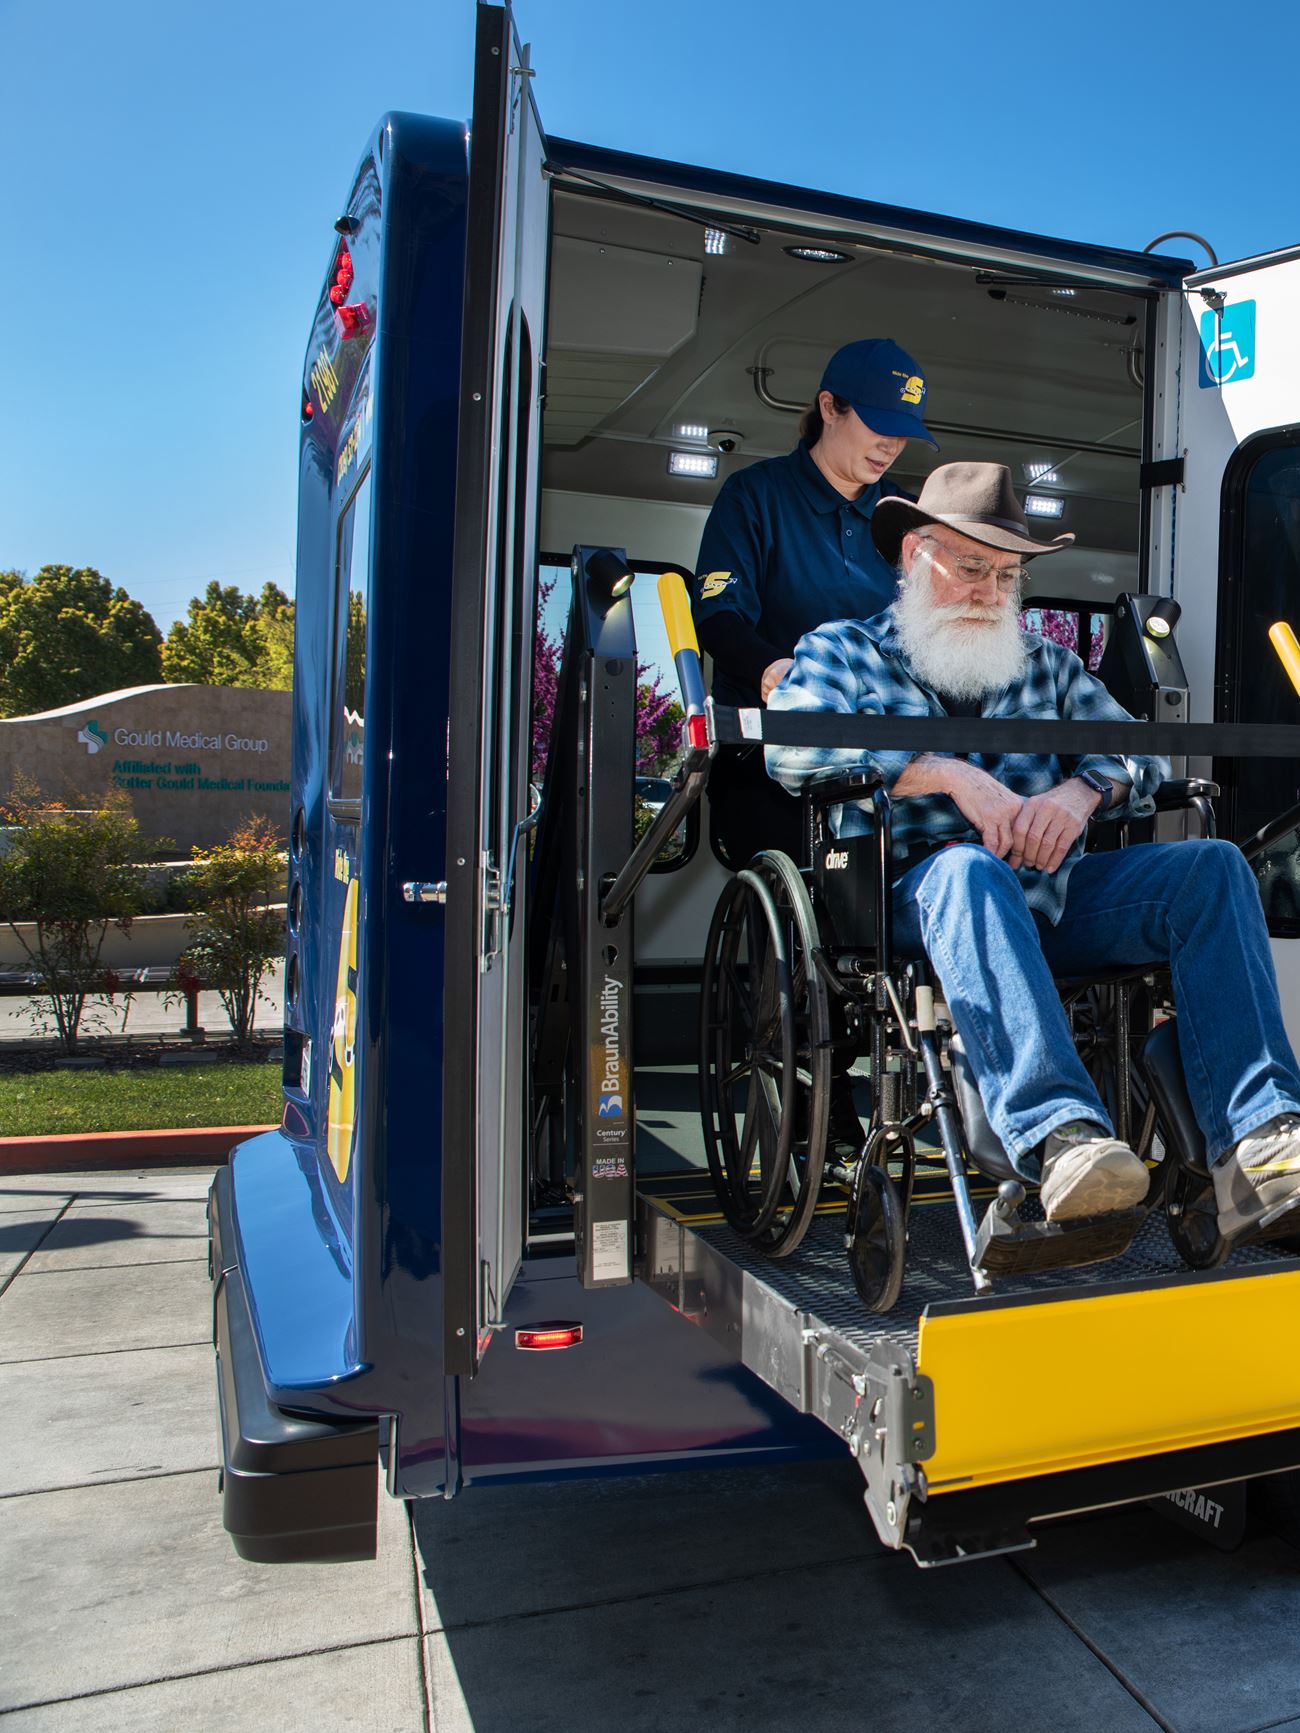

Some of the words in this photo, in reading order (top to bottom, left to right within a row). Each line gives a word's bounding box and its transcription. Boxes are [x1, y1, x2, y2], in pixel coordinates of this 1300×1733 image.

[114, 728, 162, 748] Gould
[166, 731, 221, 750] Medical
[225, 735, 268, 753] Group
[112, 760, 171, 774] Affiliated
[175, 761, 201, 775] with
[156, 777, 194, 790] Gould
[198, 778, 244, 792] Medical
[601, 974, 624, 1092] BraunAbility
[596, 1129, 626, 1137] Century
[592, 1164, 629, 1178] USA
